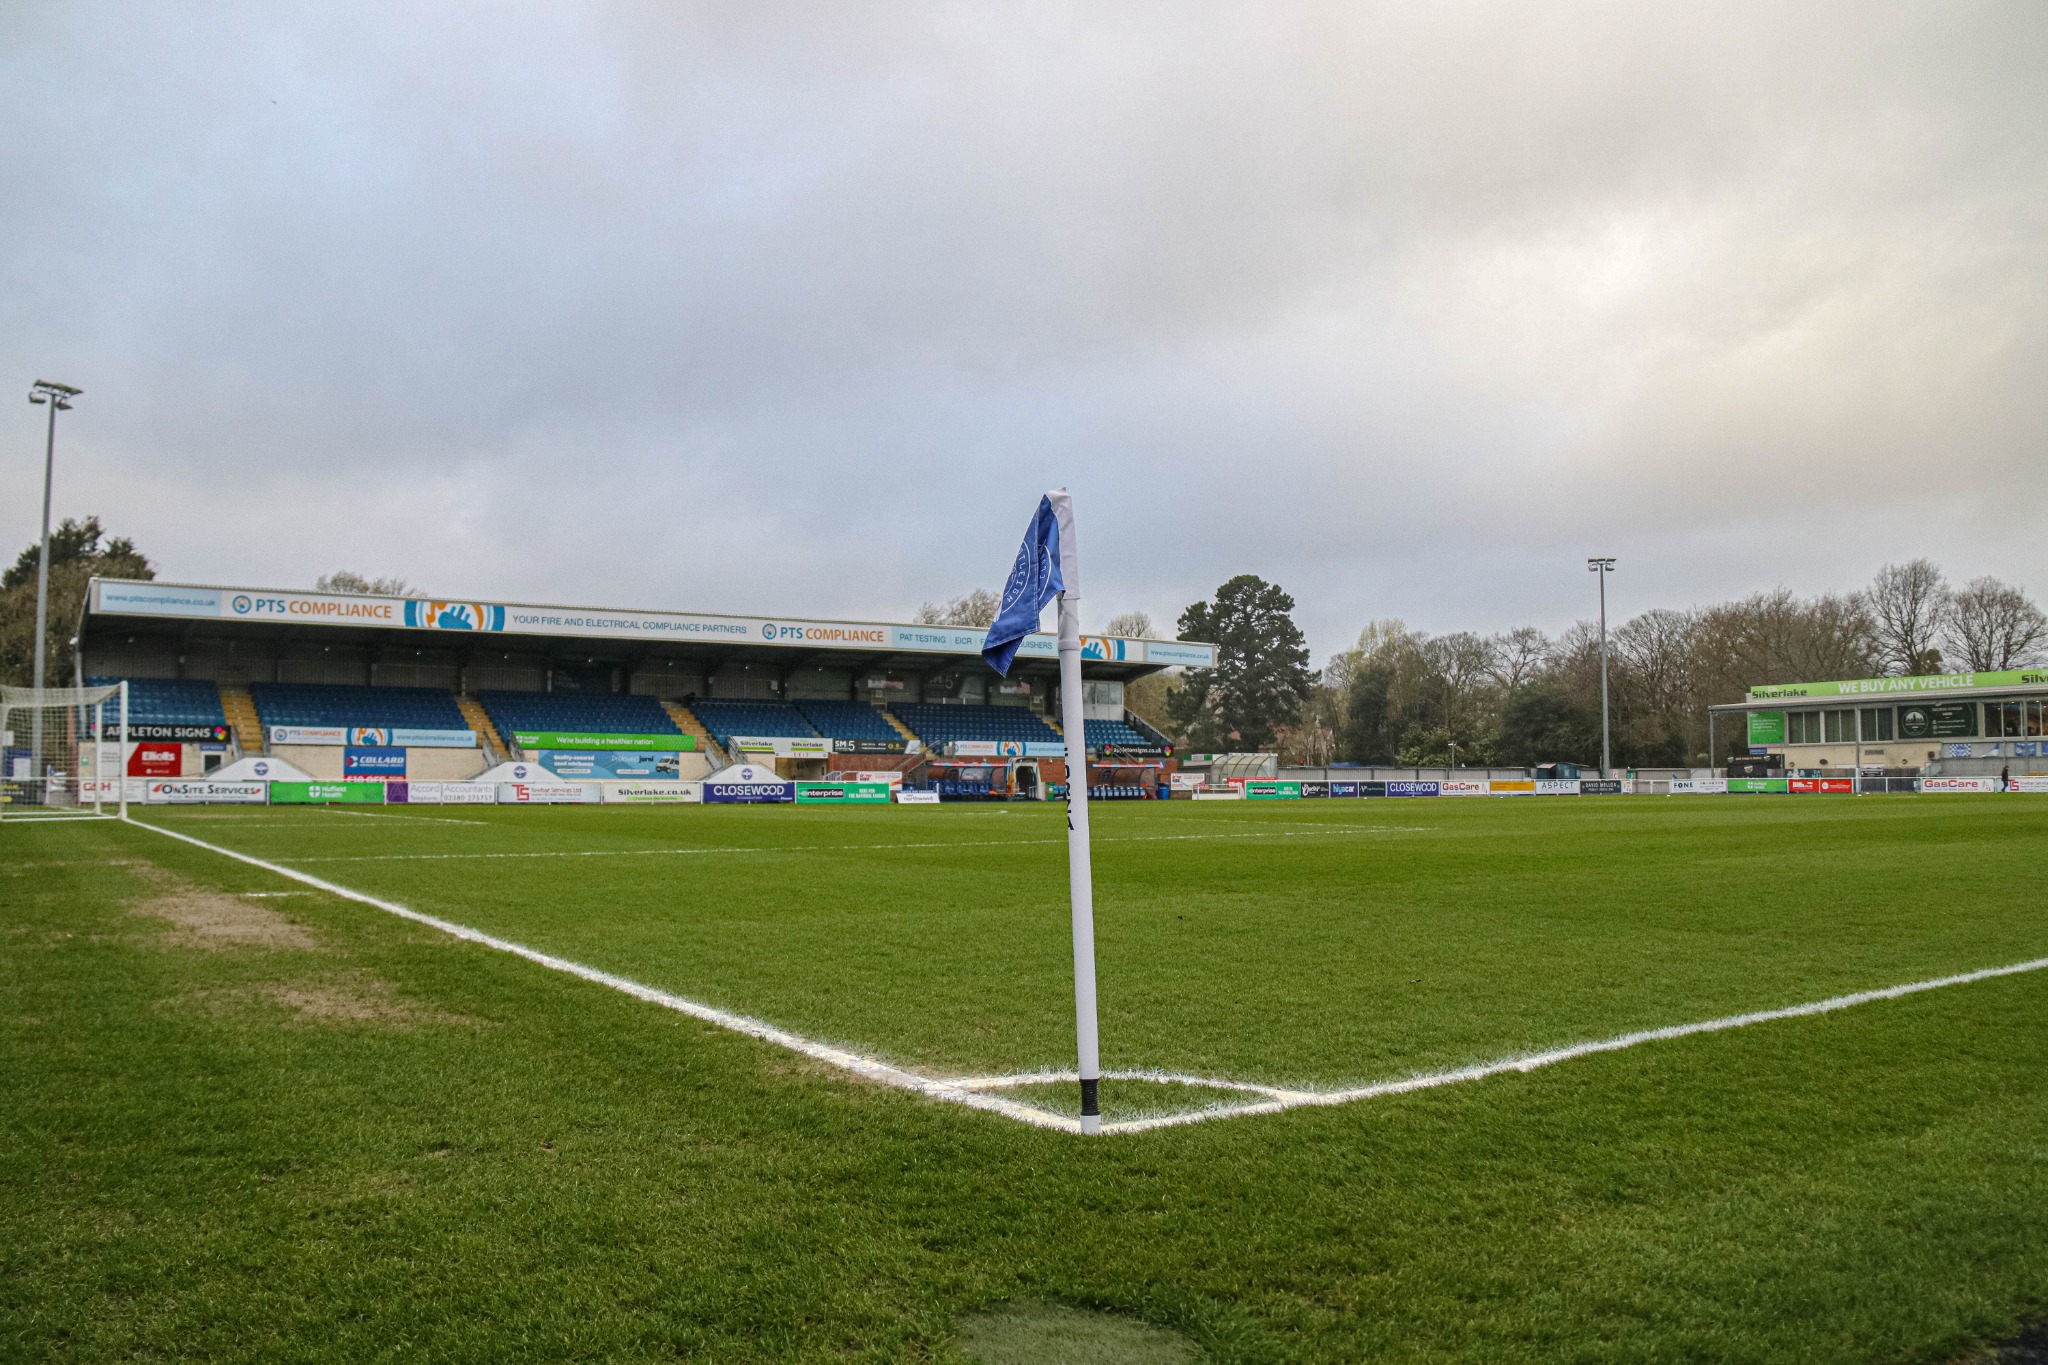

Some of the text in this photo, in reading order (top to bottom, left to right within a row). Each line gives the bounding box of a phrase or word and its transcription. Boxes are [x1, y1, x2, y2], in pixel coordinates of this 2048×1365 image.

[106, 593, 215, 607] www.ptscompliance.co.uk
[256, 599, 392, 618] PTS COMPLIANCE
[513, 614, 747, 634] YOUR FIRE AND ELECTRICAL COMPLIANCE PARTNERS
[780, 626, 884, 643] PTS COMPLIANCE
[900, 633, 946, 644] PAT TESTING
[955, 636, 972, 645] EICR
[1150, 649, 1209, 660] www.ptscompliance.co.uk
[1838, 675, 1974, 694] WE BUY ANY VEHICLE
[1752, 688, 1807, 699] Silverlake
[175, 727, 210, 738] SIGNS
[302, 730, 341, 738] COMPLIANCE
[575, 737, 600, 745] building
[410, 784, 493, 793] Accord Accountants
[1332, 783, 1355, 794] hiyacar
[1390, 783, 1437, 792] CLOSEWOOD
[1442, 782, 1480, 791] GasCare
[1542, 781, 1574, 789] ASPECT
[1673, 781, 1694, 789] FONE
[1924, 780, 1978, 788] GasCare
[511, 784, 530, 801] TS
[713, 785, 785, 796] CLOSEWOOD
[801, 789, 844, 798] enterprise
